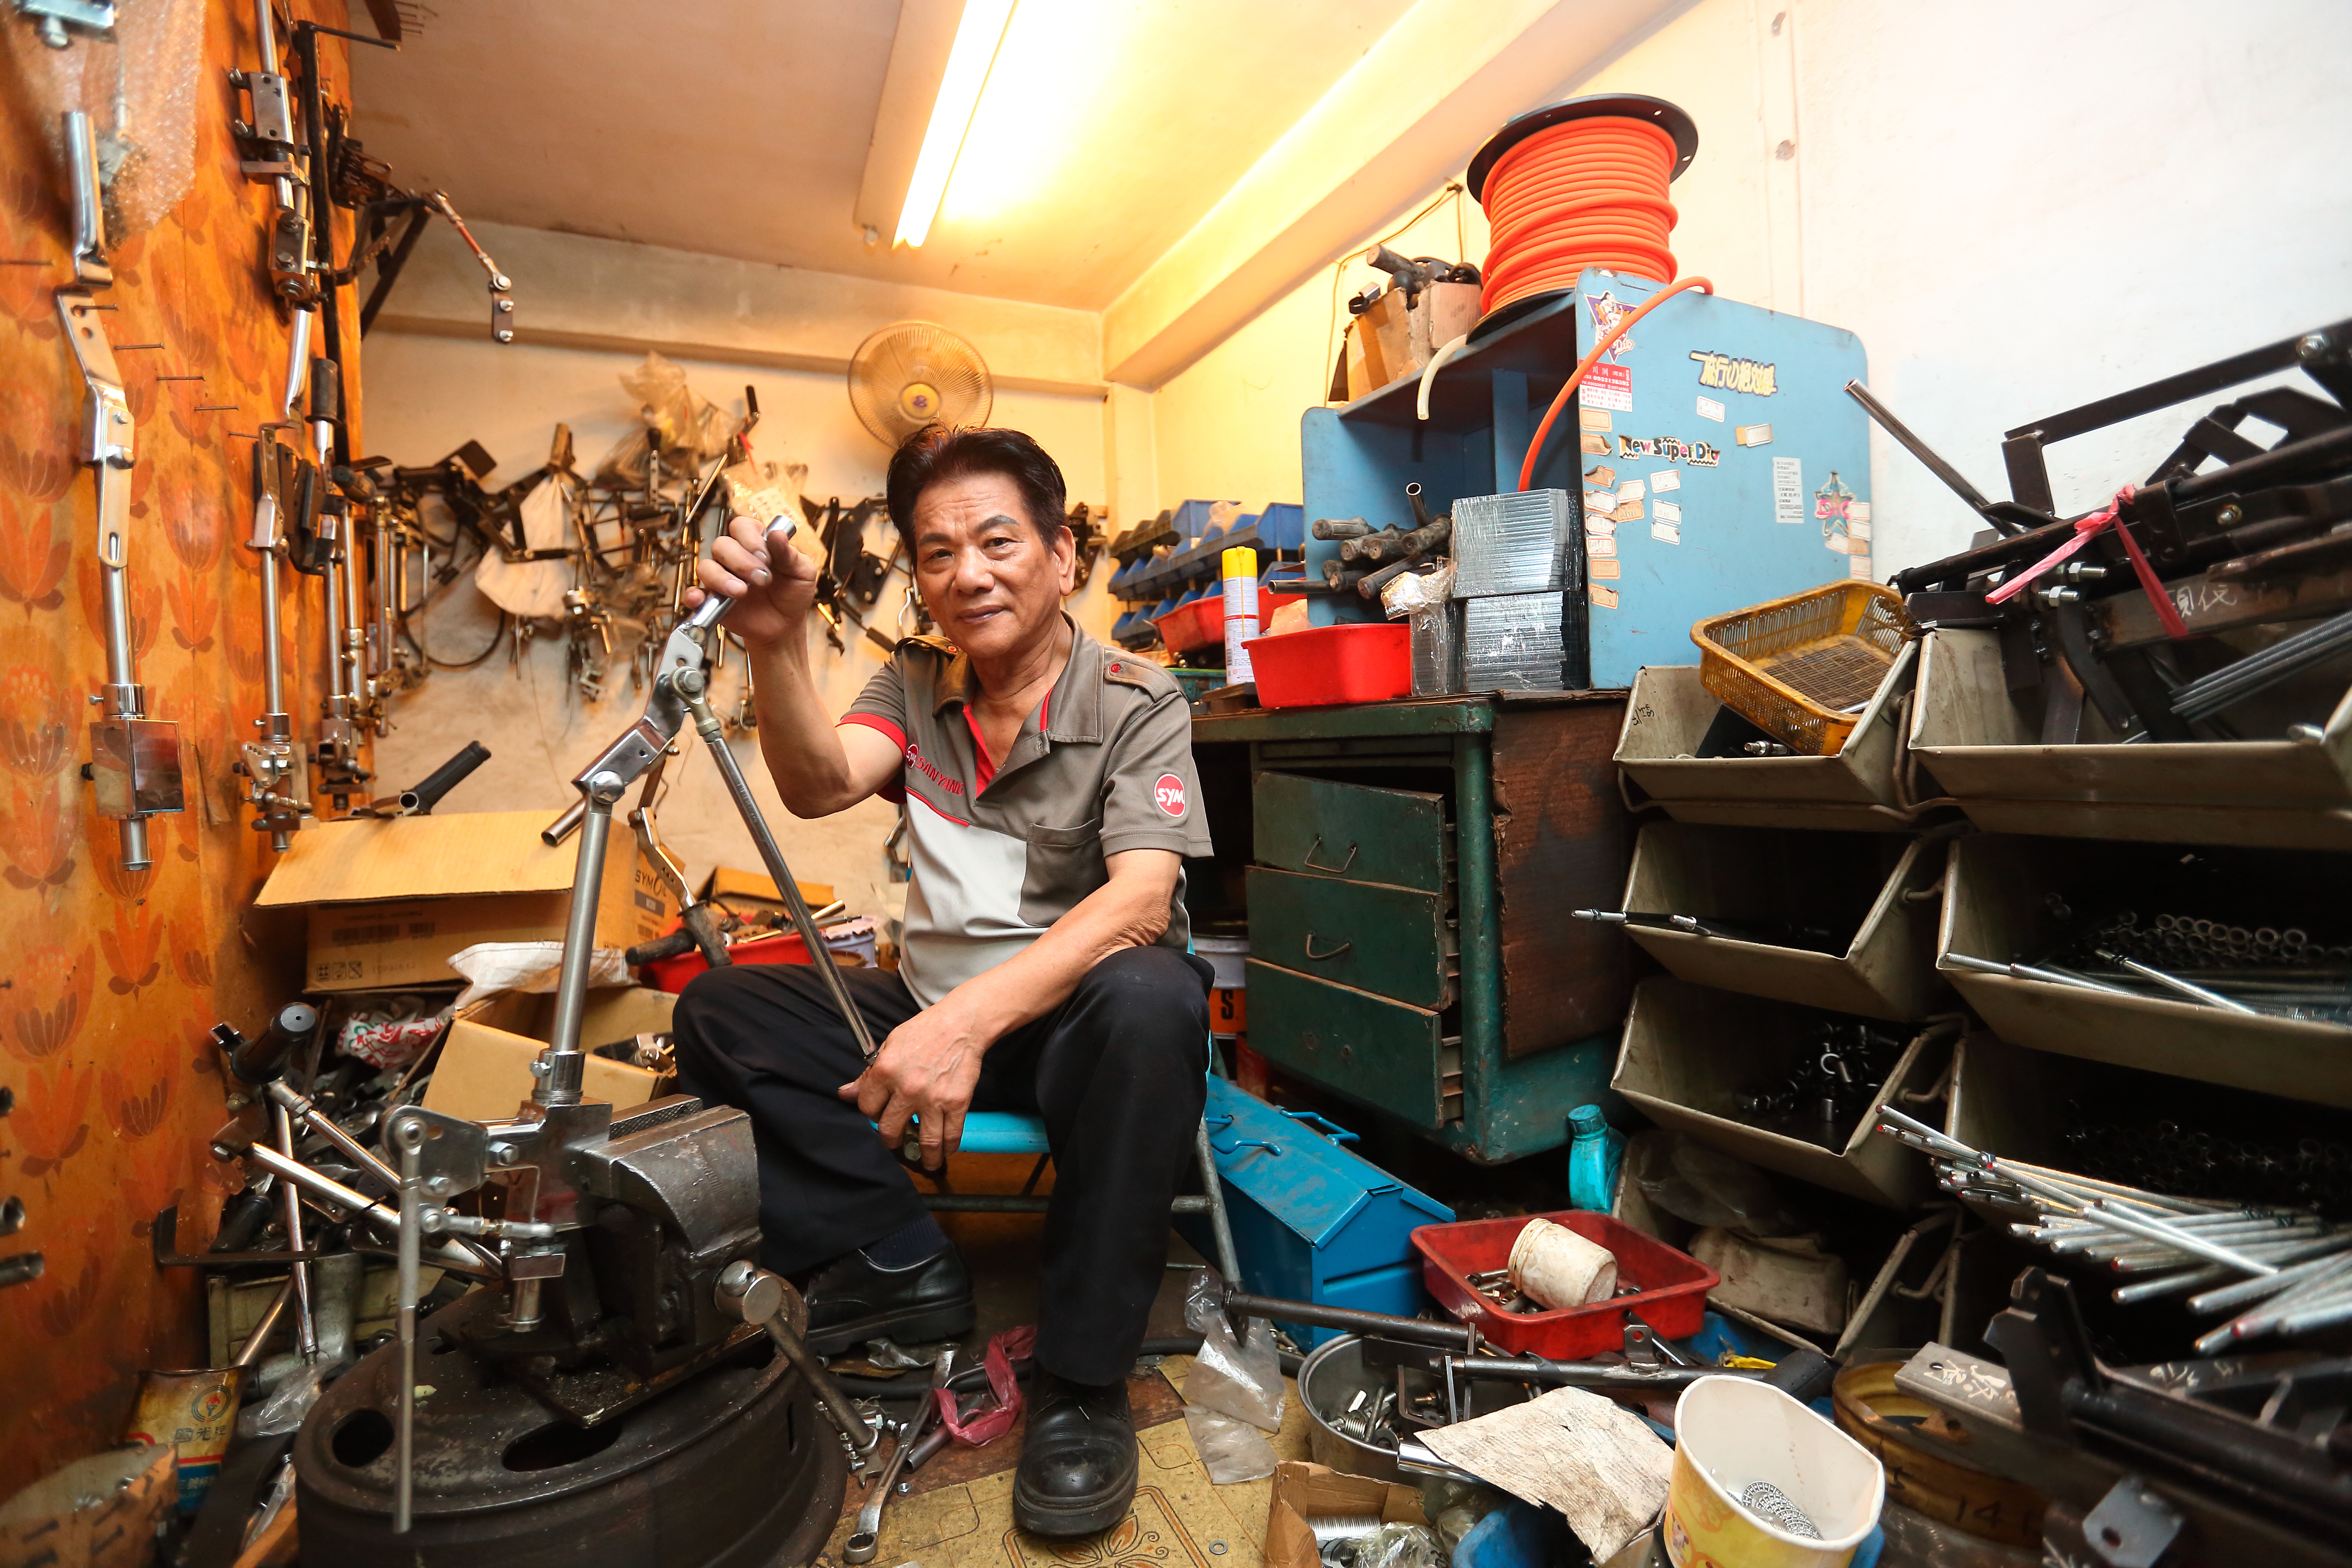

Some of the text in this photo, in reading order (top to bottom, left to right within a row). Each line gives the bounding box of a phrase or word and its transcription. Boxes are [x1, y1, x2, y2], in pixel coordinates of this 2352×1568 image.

[1614, 339, 1634, 354] Dio
[1621, 439, 1719, 461] New Super Dio
[915, 756, 966, 795] SANYANG
[1156, 788, 1185, 807] SYM
[1221, 989, 1234, 1020] S
